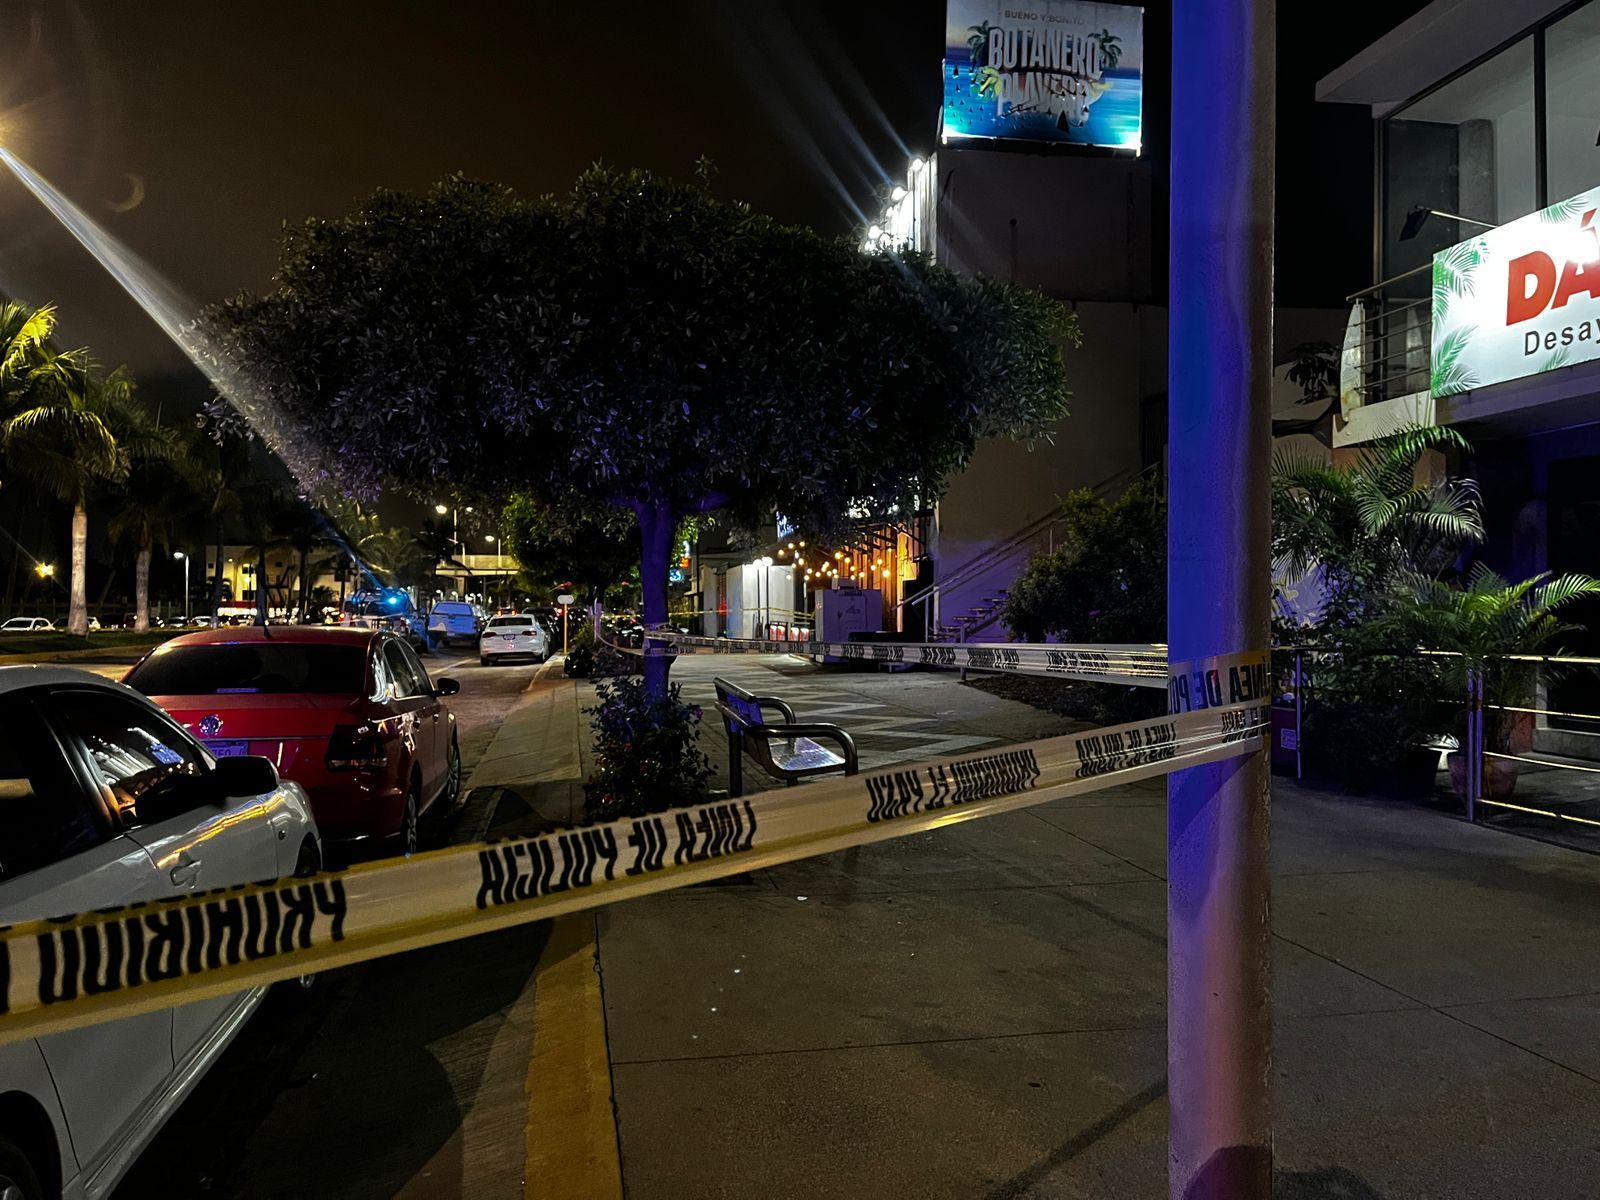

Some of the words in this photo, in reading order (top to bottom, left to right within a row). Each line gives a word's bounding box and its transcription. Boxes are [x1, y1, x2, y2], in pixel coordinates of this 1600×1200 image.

[1005, 9, 1038, 21] BUENO
[1041, 13, 1048, 22] Y
[1049, 14, 1085, 25] BONITO
